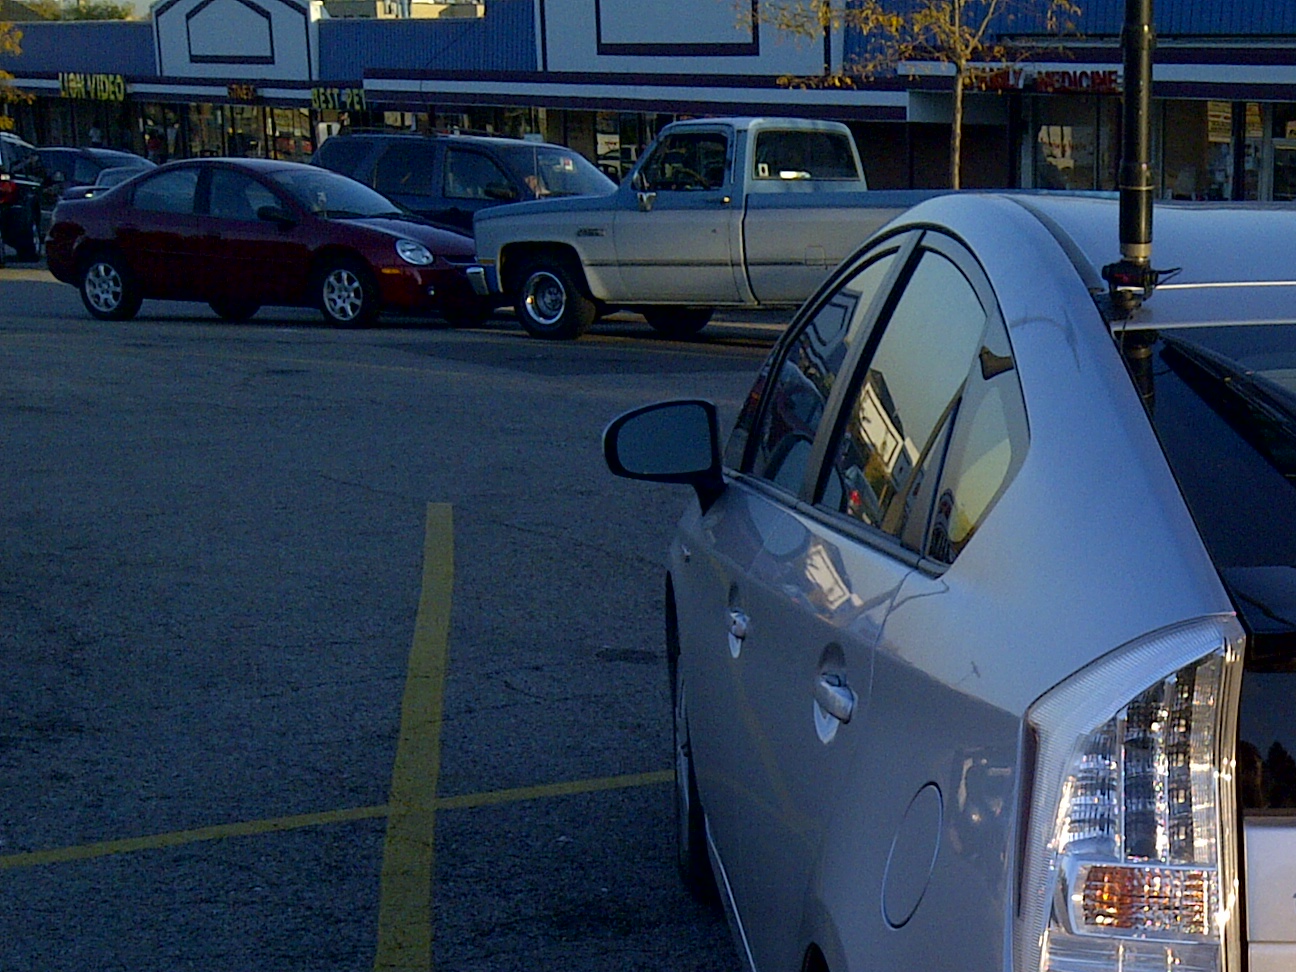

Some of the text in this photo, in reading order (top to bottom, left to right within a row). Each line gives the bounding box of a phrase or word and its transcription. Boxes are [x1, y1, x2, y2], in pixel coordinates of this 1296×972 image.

[86, 74, 125, 102] VIDEO
[1036, 70, 1121, 92] MEDICINE
[311, 87, 340, 109] BEST
